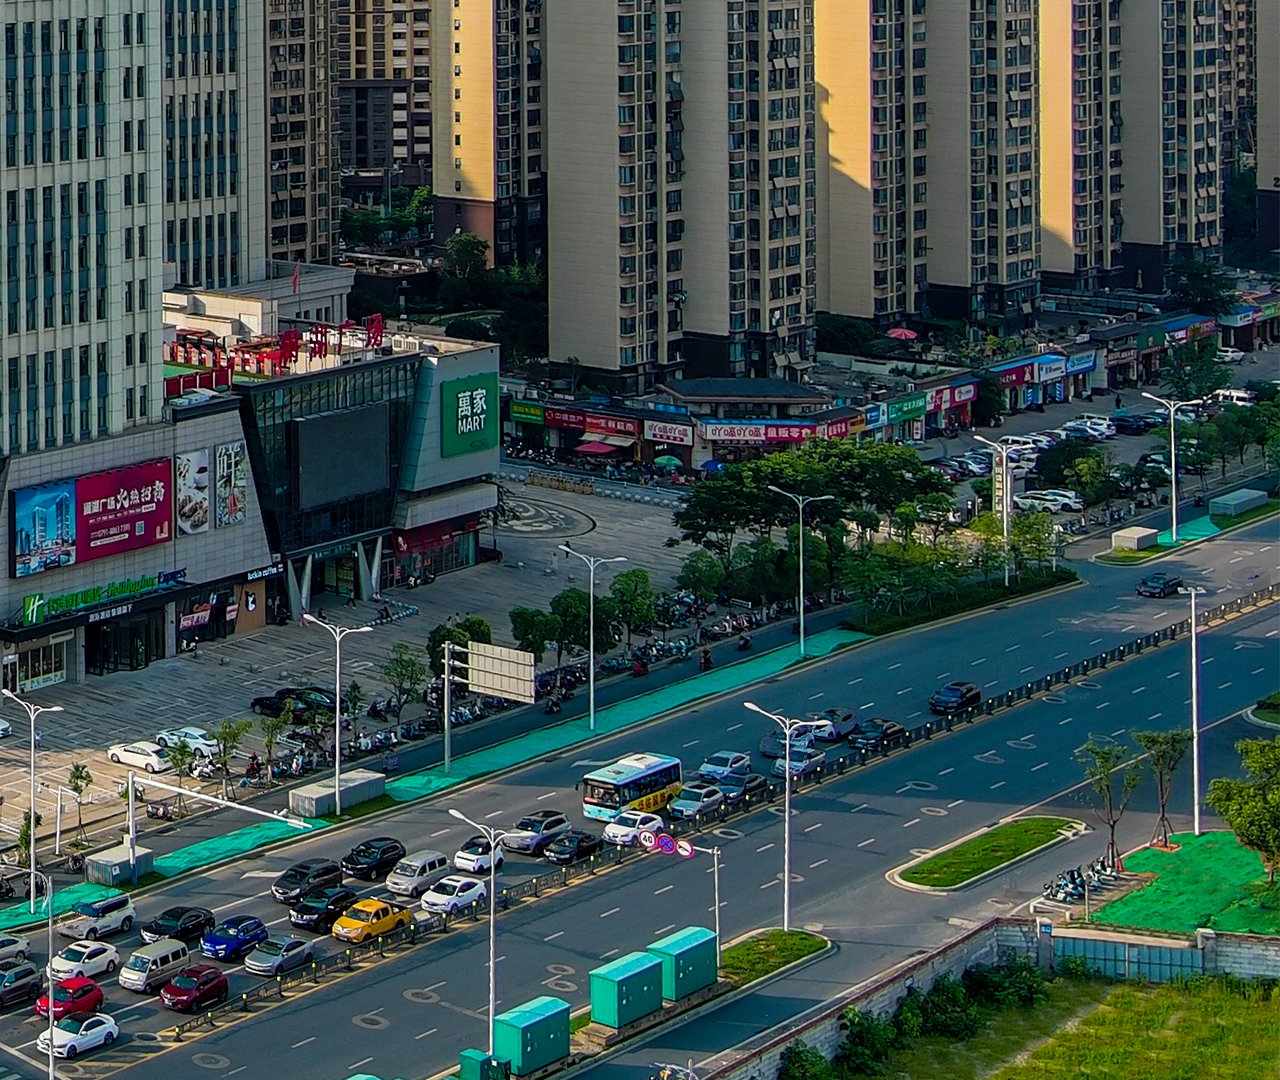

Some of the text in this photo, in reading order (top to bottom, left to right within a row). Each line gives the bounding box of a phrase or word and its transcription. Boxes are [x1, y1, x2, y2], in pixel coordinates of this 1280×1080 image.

[458, 388, 487, 419] 萬家
[458, 414, 486, 435] MART
[247, 569, 263, 581] luckin
[262, 566, 278, 577] coffee
[642, 834, 653, 845] 40
